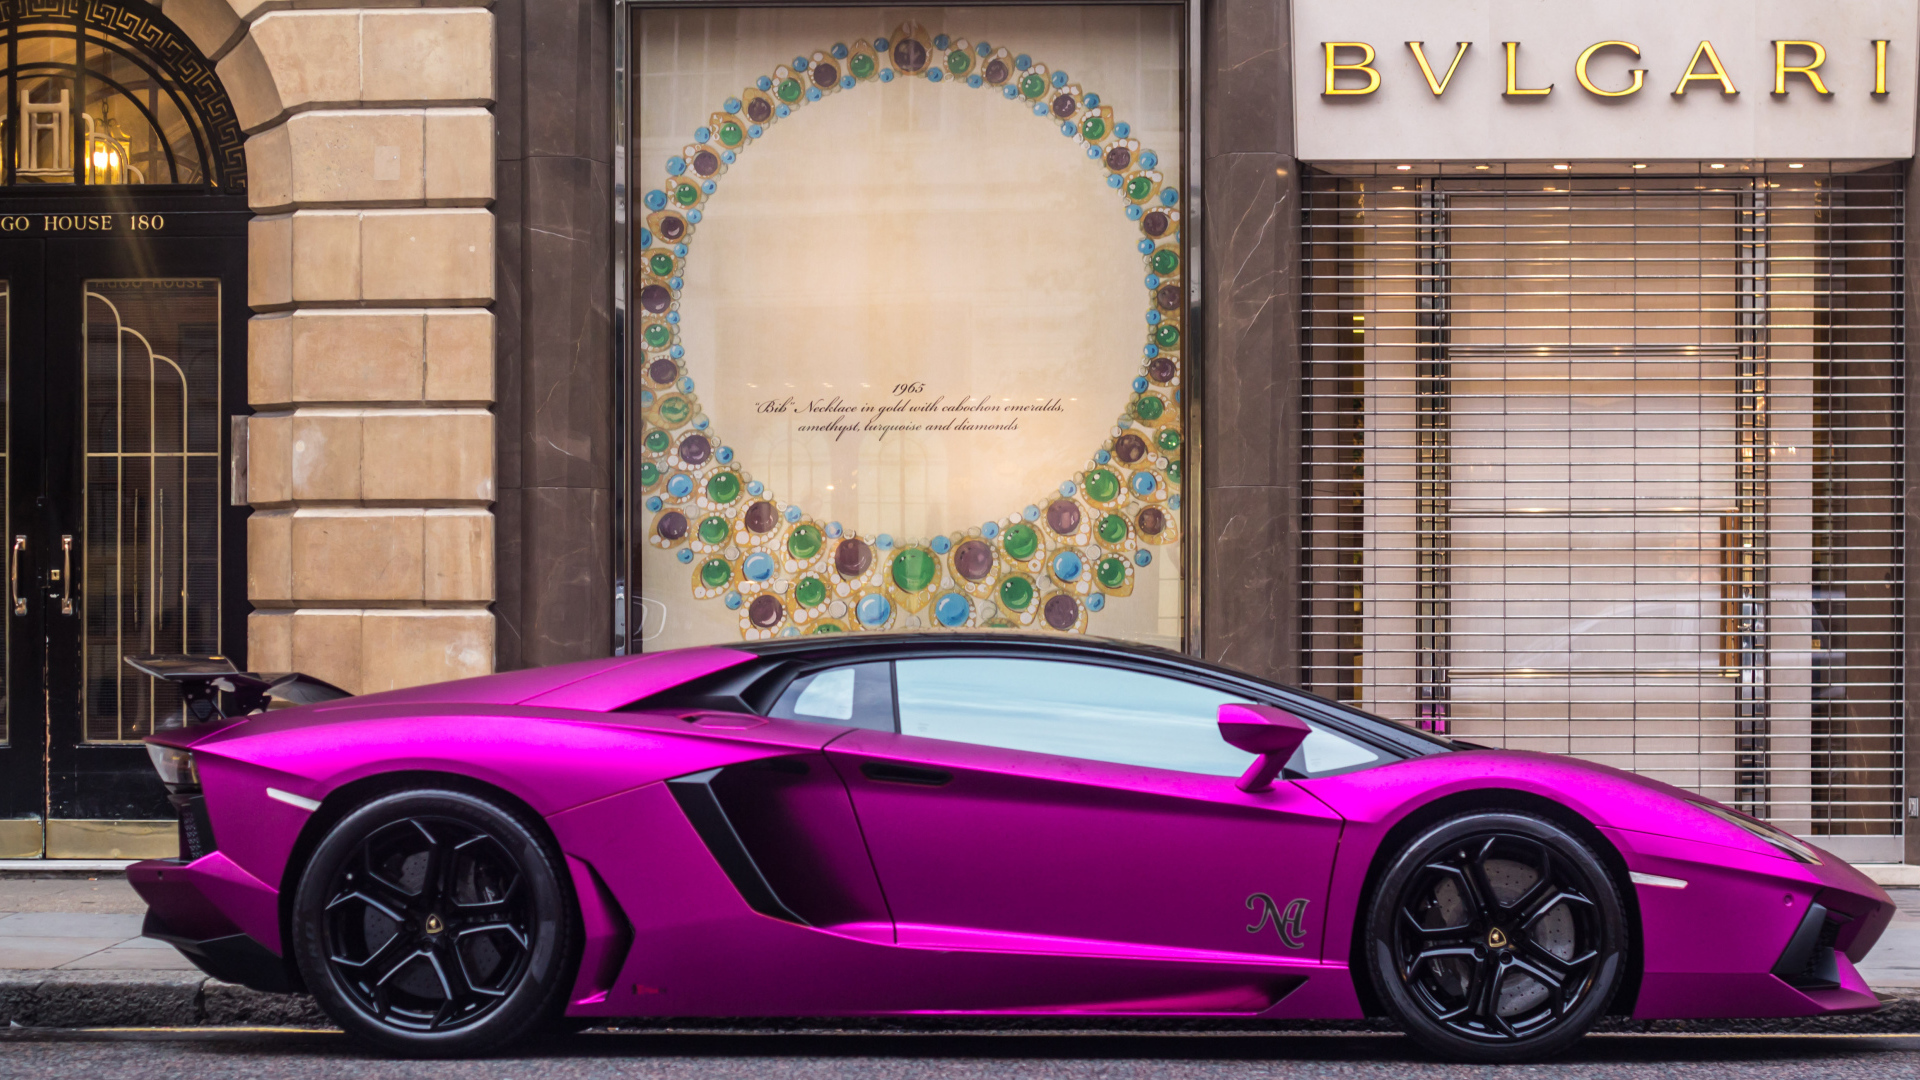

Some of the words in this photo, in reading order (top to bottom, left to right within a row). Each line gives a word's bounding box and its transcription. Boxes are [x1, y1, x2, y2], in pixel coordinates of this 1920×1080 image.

[1320, 40, 1891, 99] BVLGARI
[44, 215, 113, 231] HOUSE
[130, 214, 165, 231] 180
[891, 381, 926, 396] 1965
[794, 396, 858, 413] Necklace
[860, 402, 875, 413] in
[876, 399, 912, 423] gold
[909, 395, 944, 413] with
[941, 395, 1001, 413] cabochon
[1004, 398, 1064, 413] emeralds,
[797, 415, 861, 442] amethyst,
[863, 419, 922, 442] turquoise
[925, 418, 957, 431] and
[953, 417, 1018, 431] diamonds
